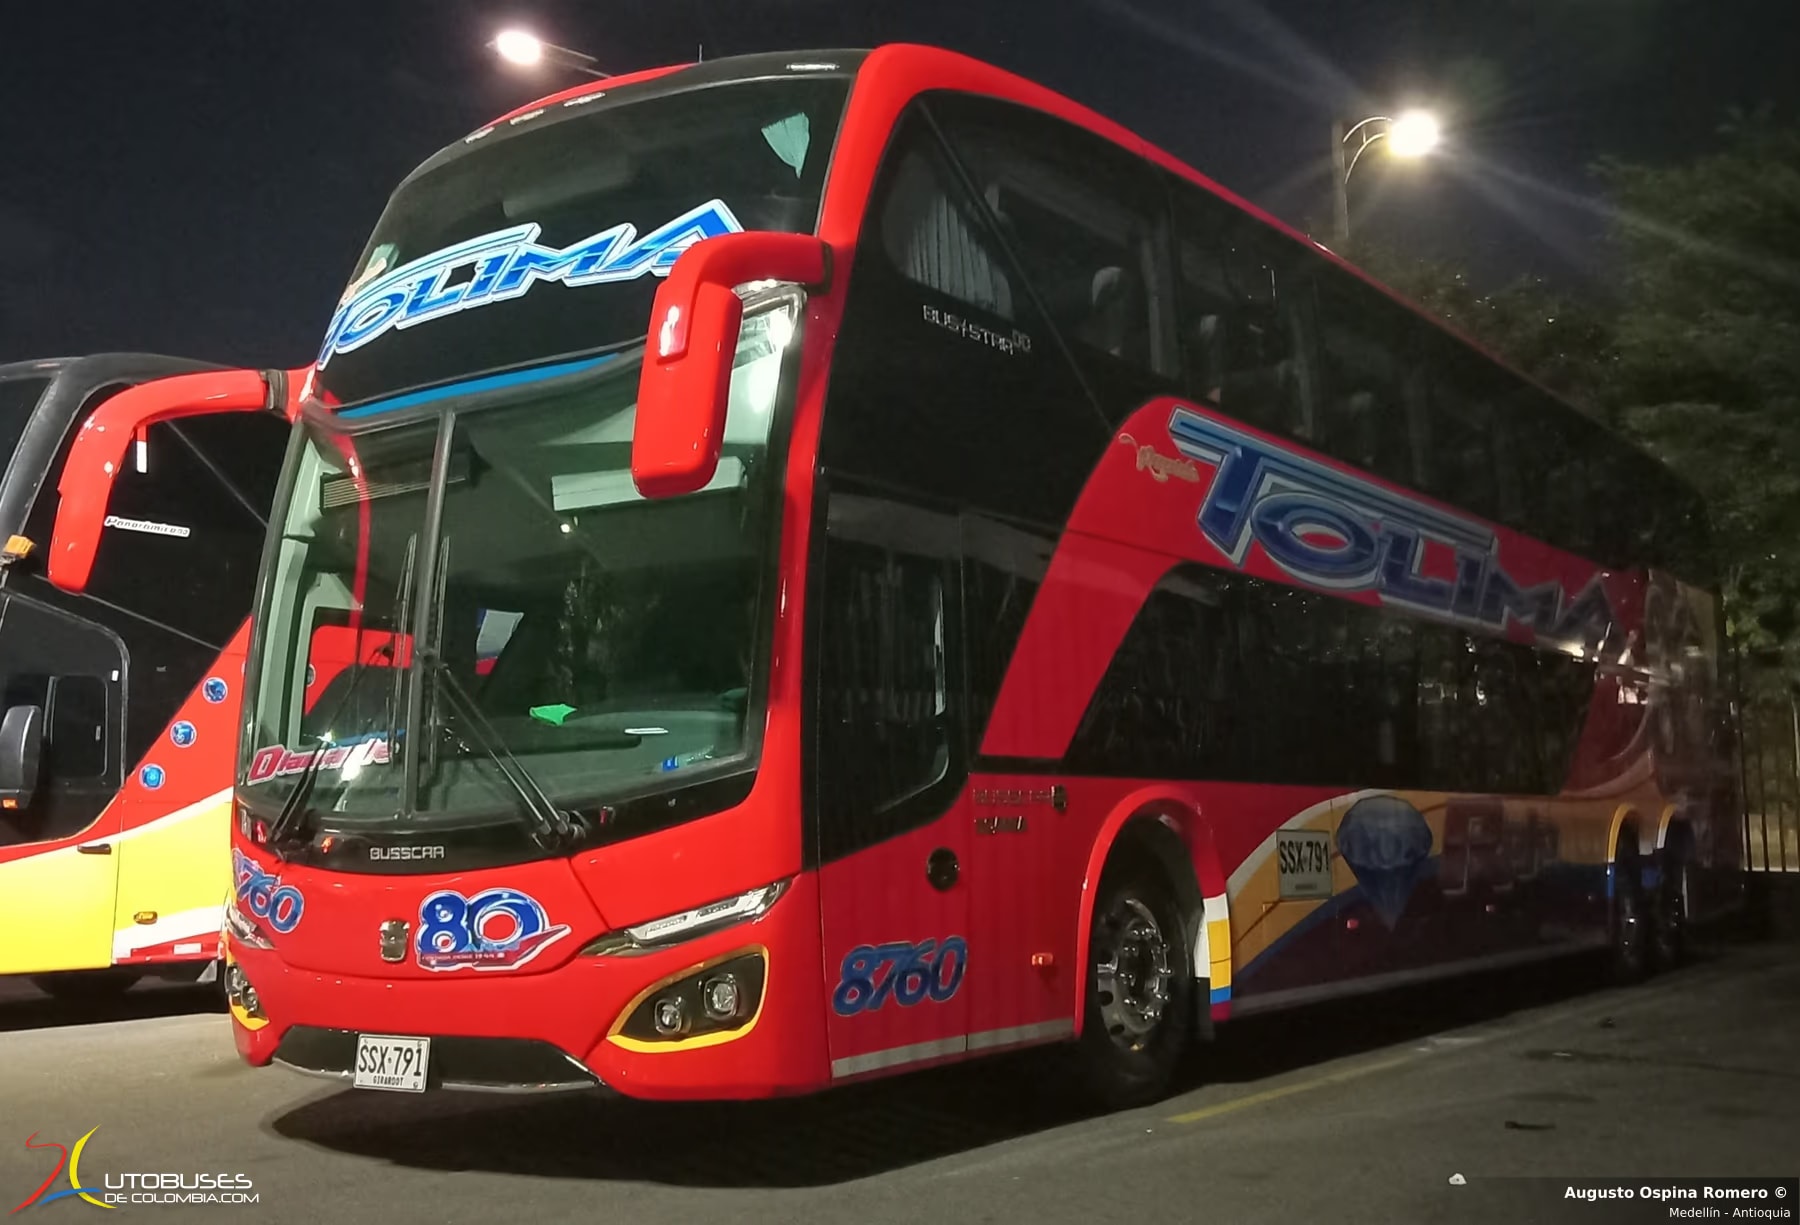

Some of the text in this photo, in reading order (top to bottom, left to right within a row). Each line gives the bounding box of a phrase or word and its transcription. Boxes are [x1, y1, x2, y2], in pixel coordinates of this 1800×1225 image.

[318, 199, 744, 371] TOLIMA
[1169, 406, 1626, 655] TOLIMA
[370, 846, 445, 861] BUSSCAR
[414, 888, 550, 954] 80
[832, 935, 968, 1017] 8760
